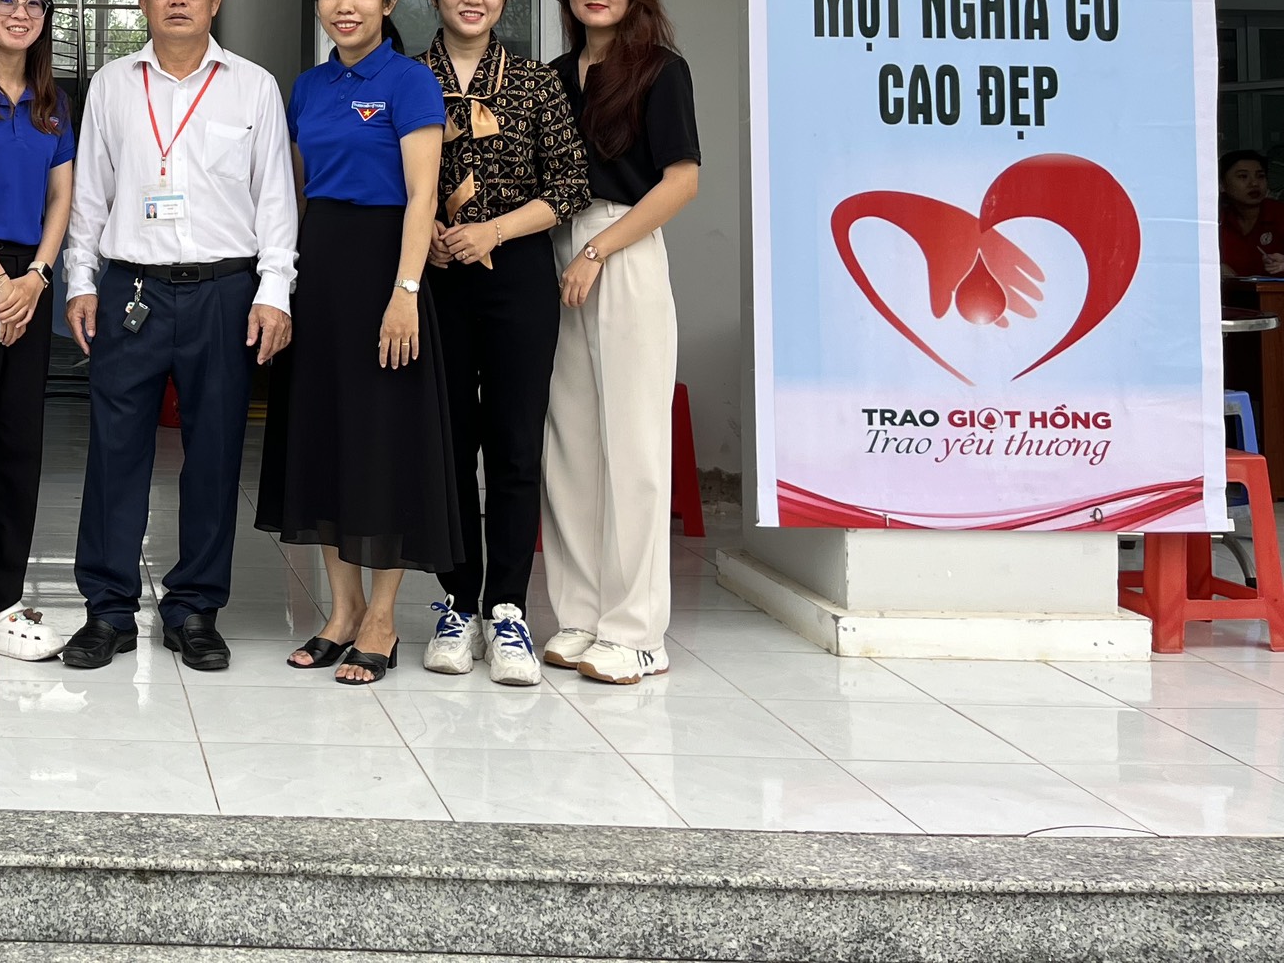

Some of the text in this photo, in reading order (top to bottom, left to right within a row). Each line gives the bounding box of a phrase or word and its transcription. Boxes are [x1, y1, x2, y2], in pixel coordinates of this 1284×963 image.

[878, 63, 1059, 140] CAO ĐẸP
[862, 404, 1112, 433] TRAO GIỌT HỒNG
[864, 429, 1112, 465] Trao yêu thương
